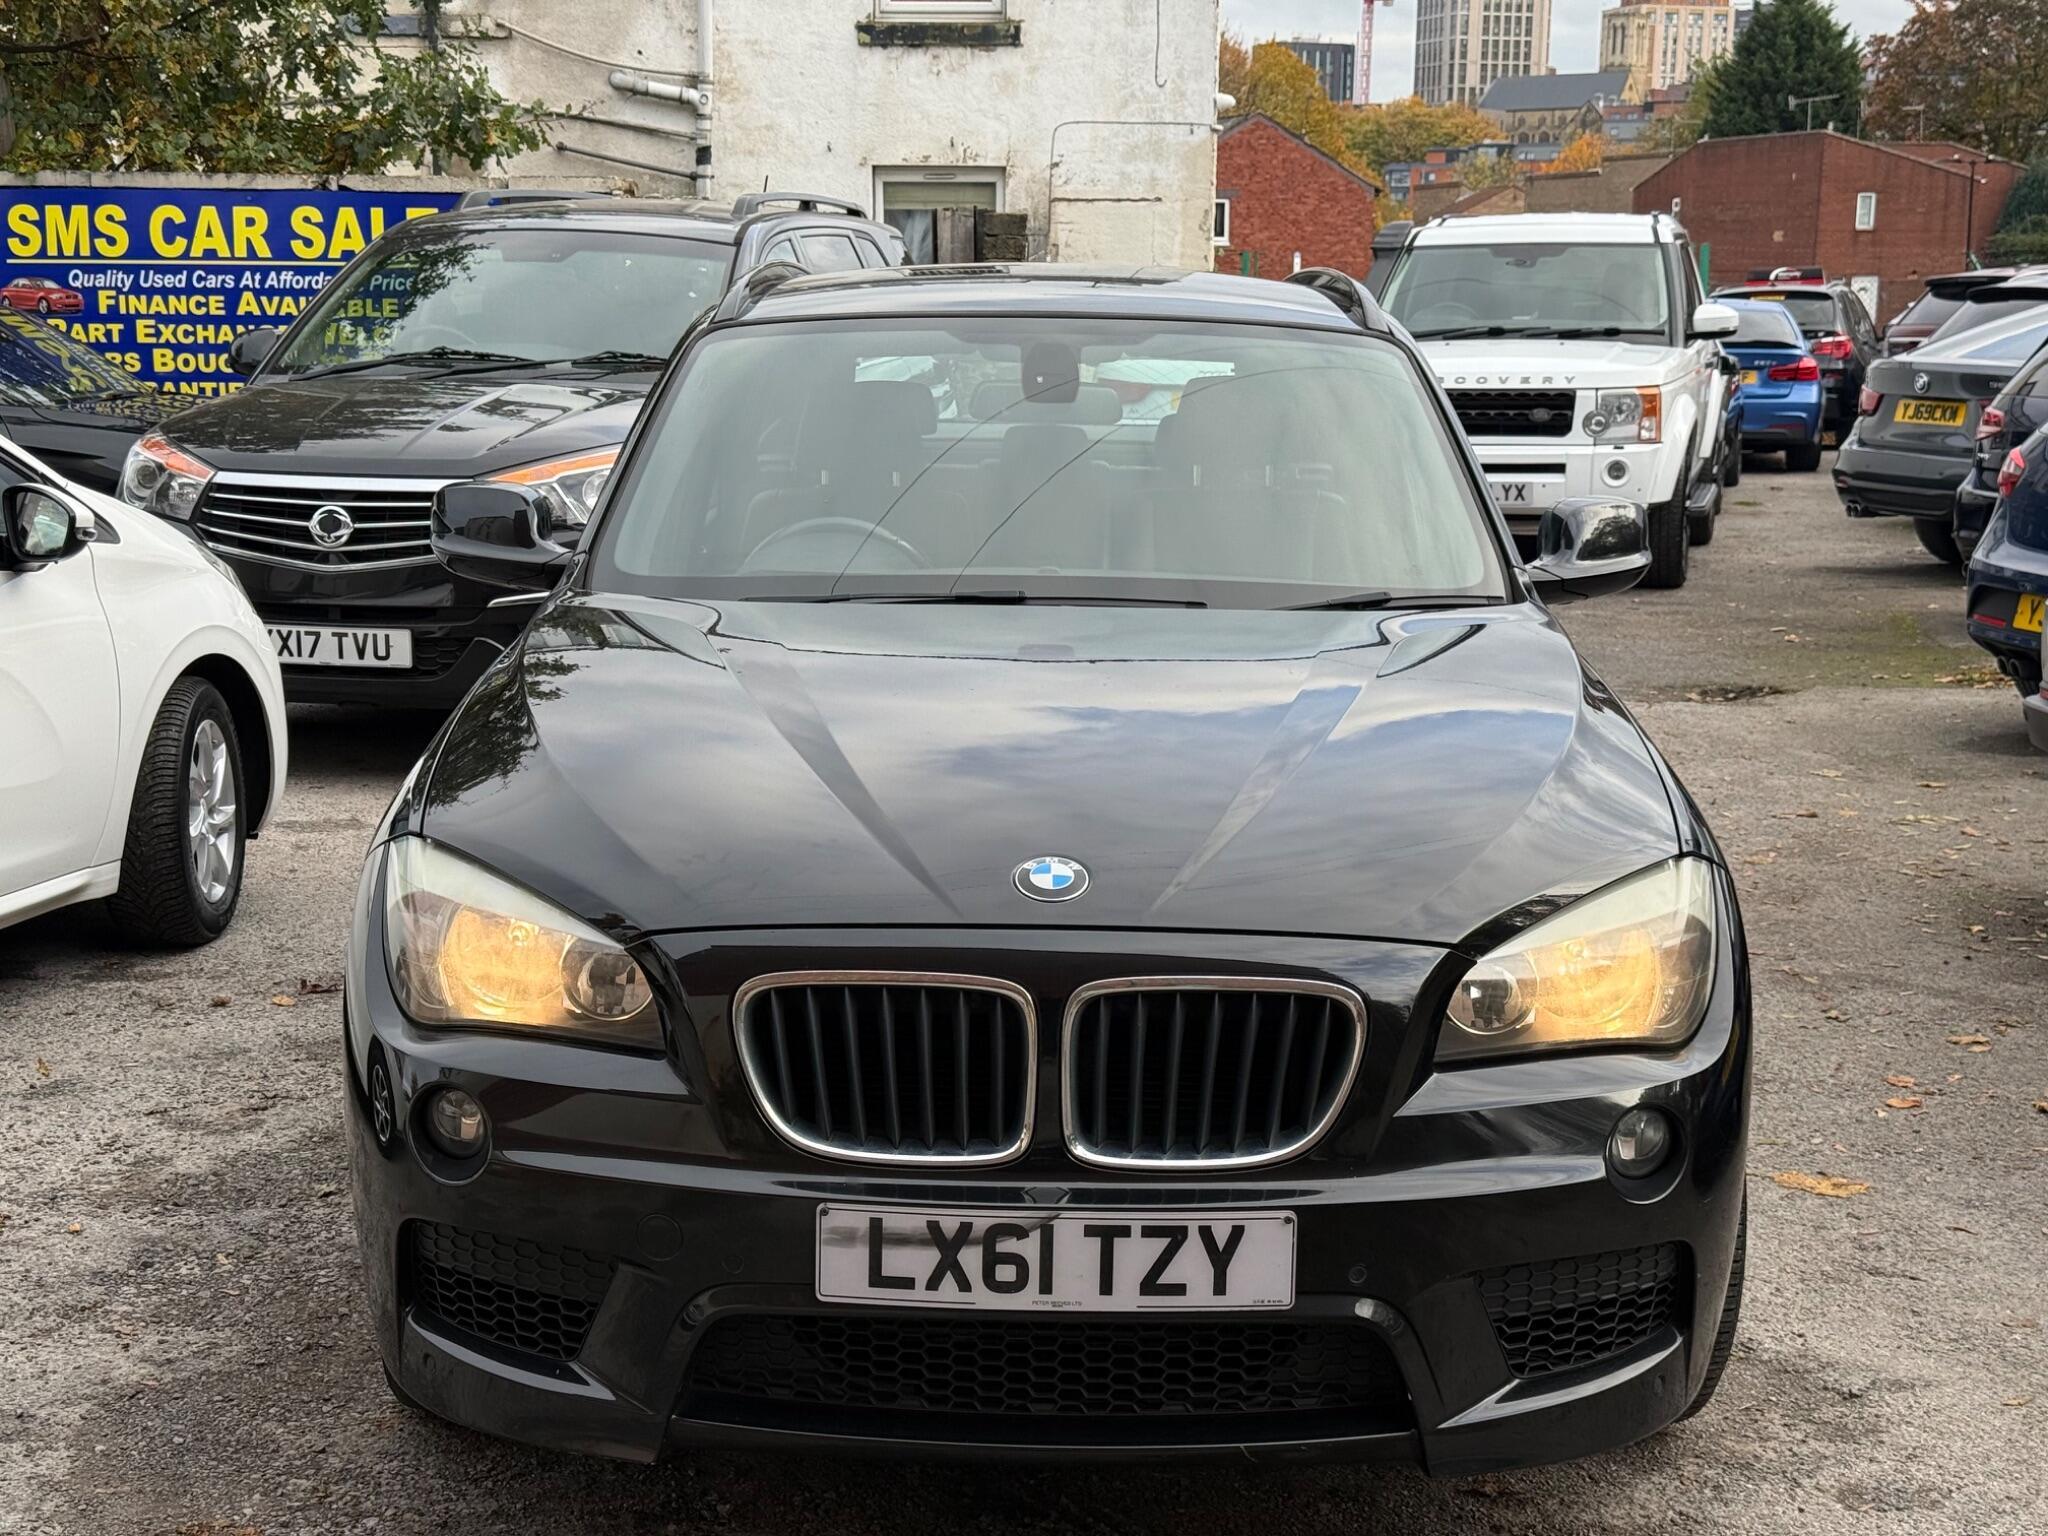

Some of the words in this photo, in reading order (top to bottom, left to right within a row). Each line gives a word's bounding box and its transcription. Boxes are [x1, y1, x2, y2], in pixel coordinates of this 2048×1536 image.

[6, 203, 130, 258] SMS
[149, 204, 272, 259] CAR
[68, 268, 134, 292] Quality
[139, 269, 188, 288] Used
[192, 270, 235, 289] Cars
[240, 270, 262, 289] At
[97, 290, 226, 316] FINANCE
[267, 628, 321, 659] X17
[331, 631, 391, 661] TVU
[868, 1216, 1055, 1296] LX61
[1083, 1224, 1246, 1297] TZY
